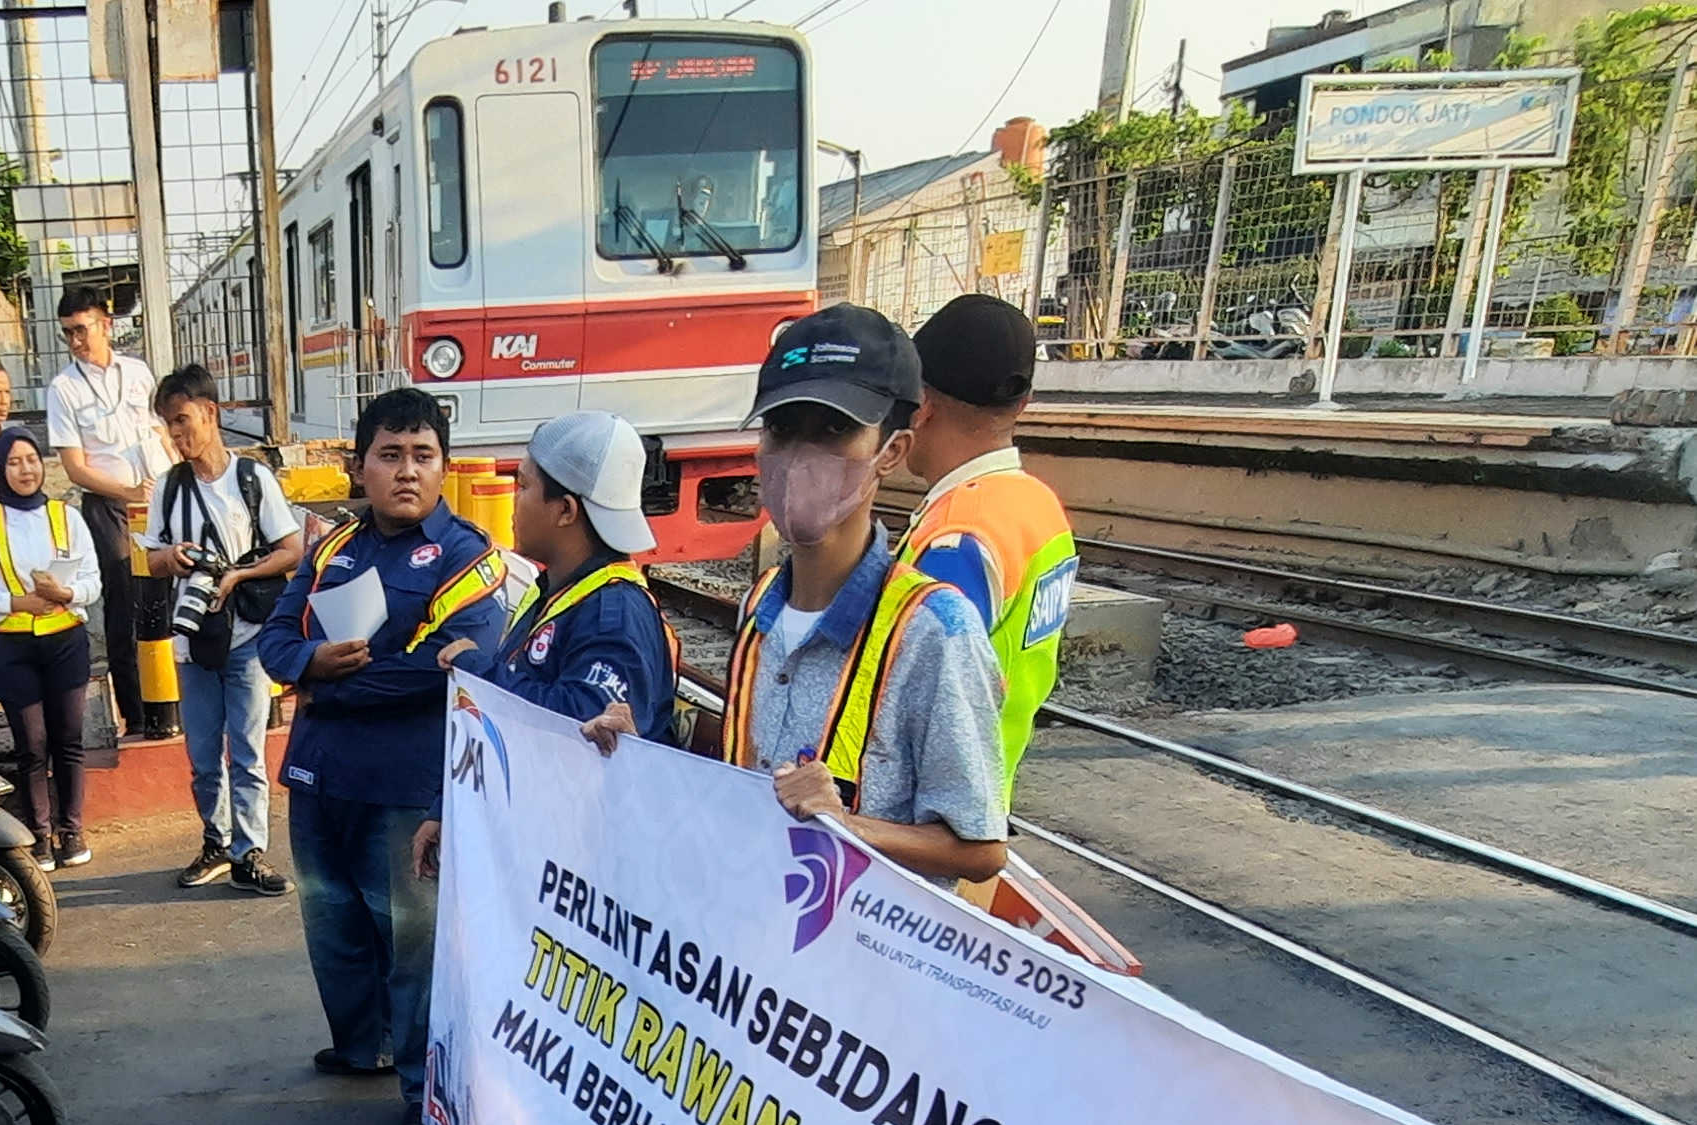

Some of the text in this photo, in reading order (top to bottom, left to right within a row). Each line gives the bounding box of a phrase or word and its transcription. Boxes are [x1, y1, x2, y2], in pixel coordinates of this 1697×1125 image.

[495, 57, 557, 84] 6121
[1330, 103, 1471, 126] PONDOK JATI
[491, 335, 538, 359] KAI
[521, 360, 576, 372] Commuter
[538, 859, 753, 1028] PERLINTASAN
[850, 889, 1087, 1010] HARHUBNAS 2023
[524, 925, 628, 1049] TITIK
[888, 947, 926, 972] UNTUK
[923, 963, 1016, 1013] TRANSPORTASI
[1013, 1003, 1052, 1030] MAJU
[491, 999, 575, 1096] MAKA
